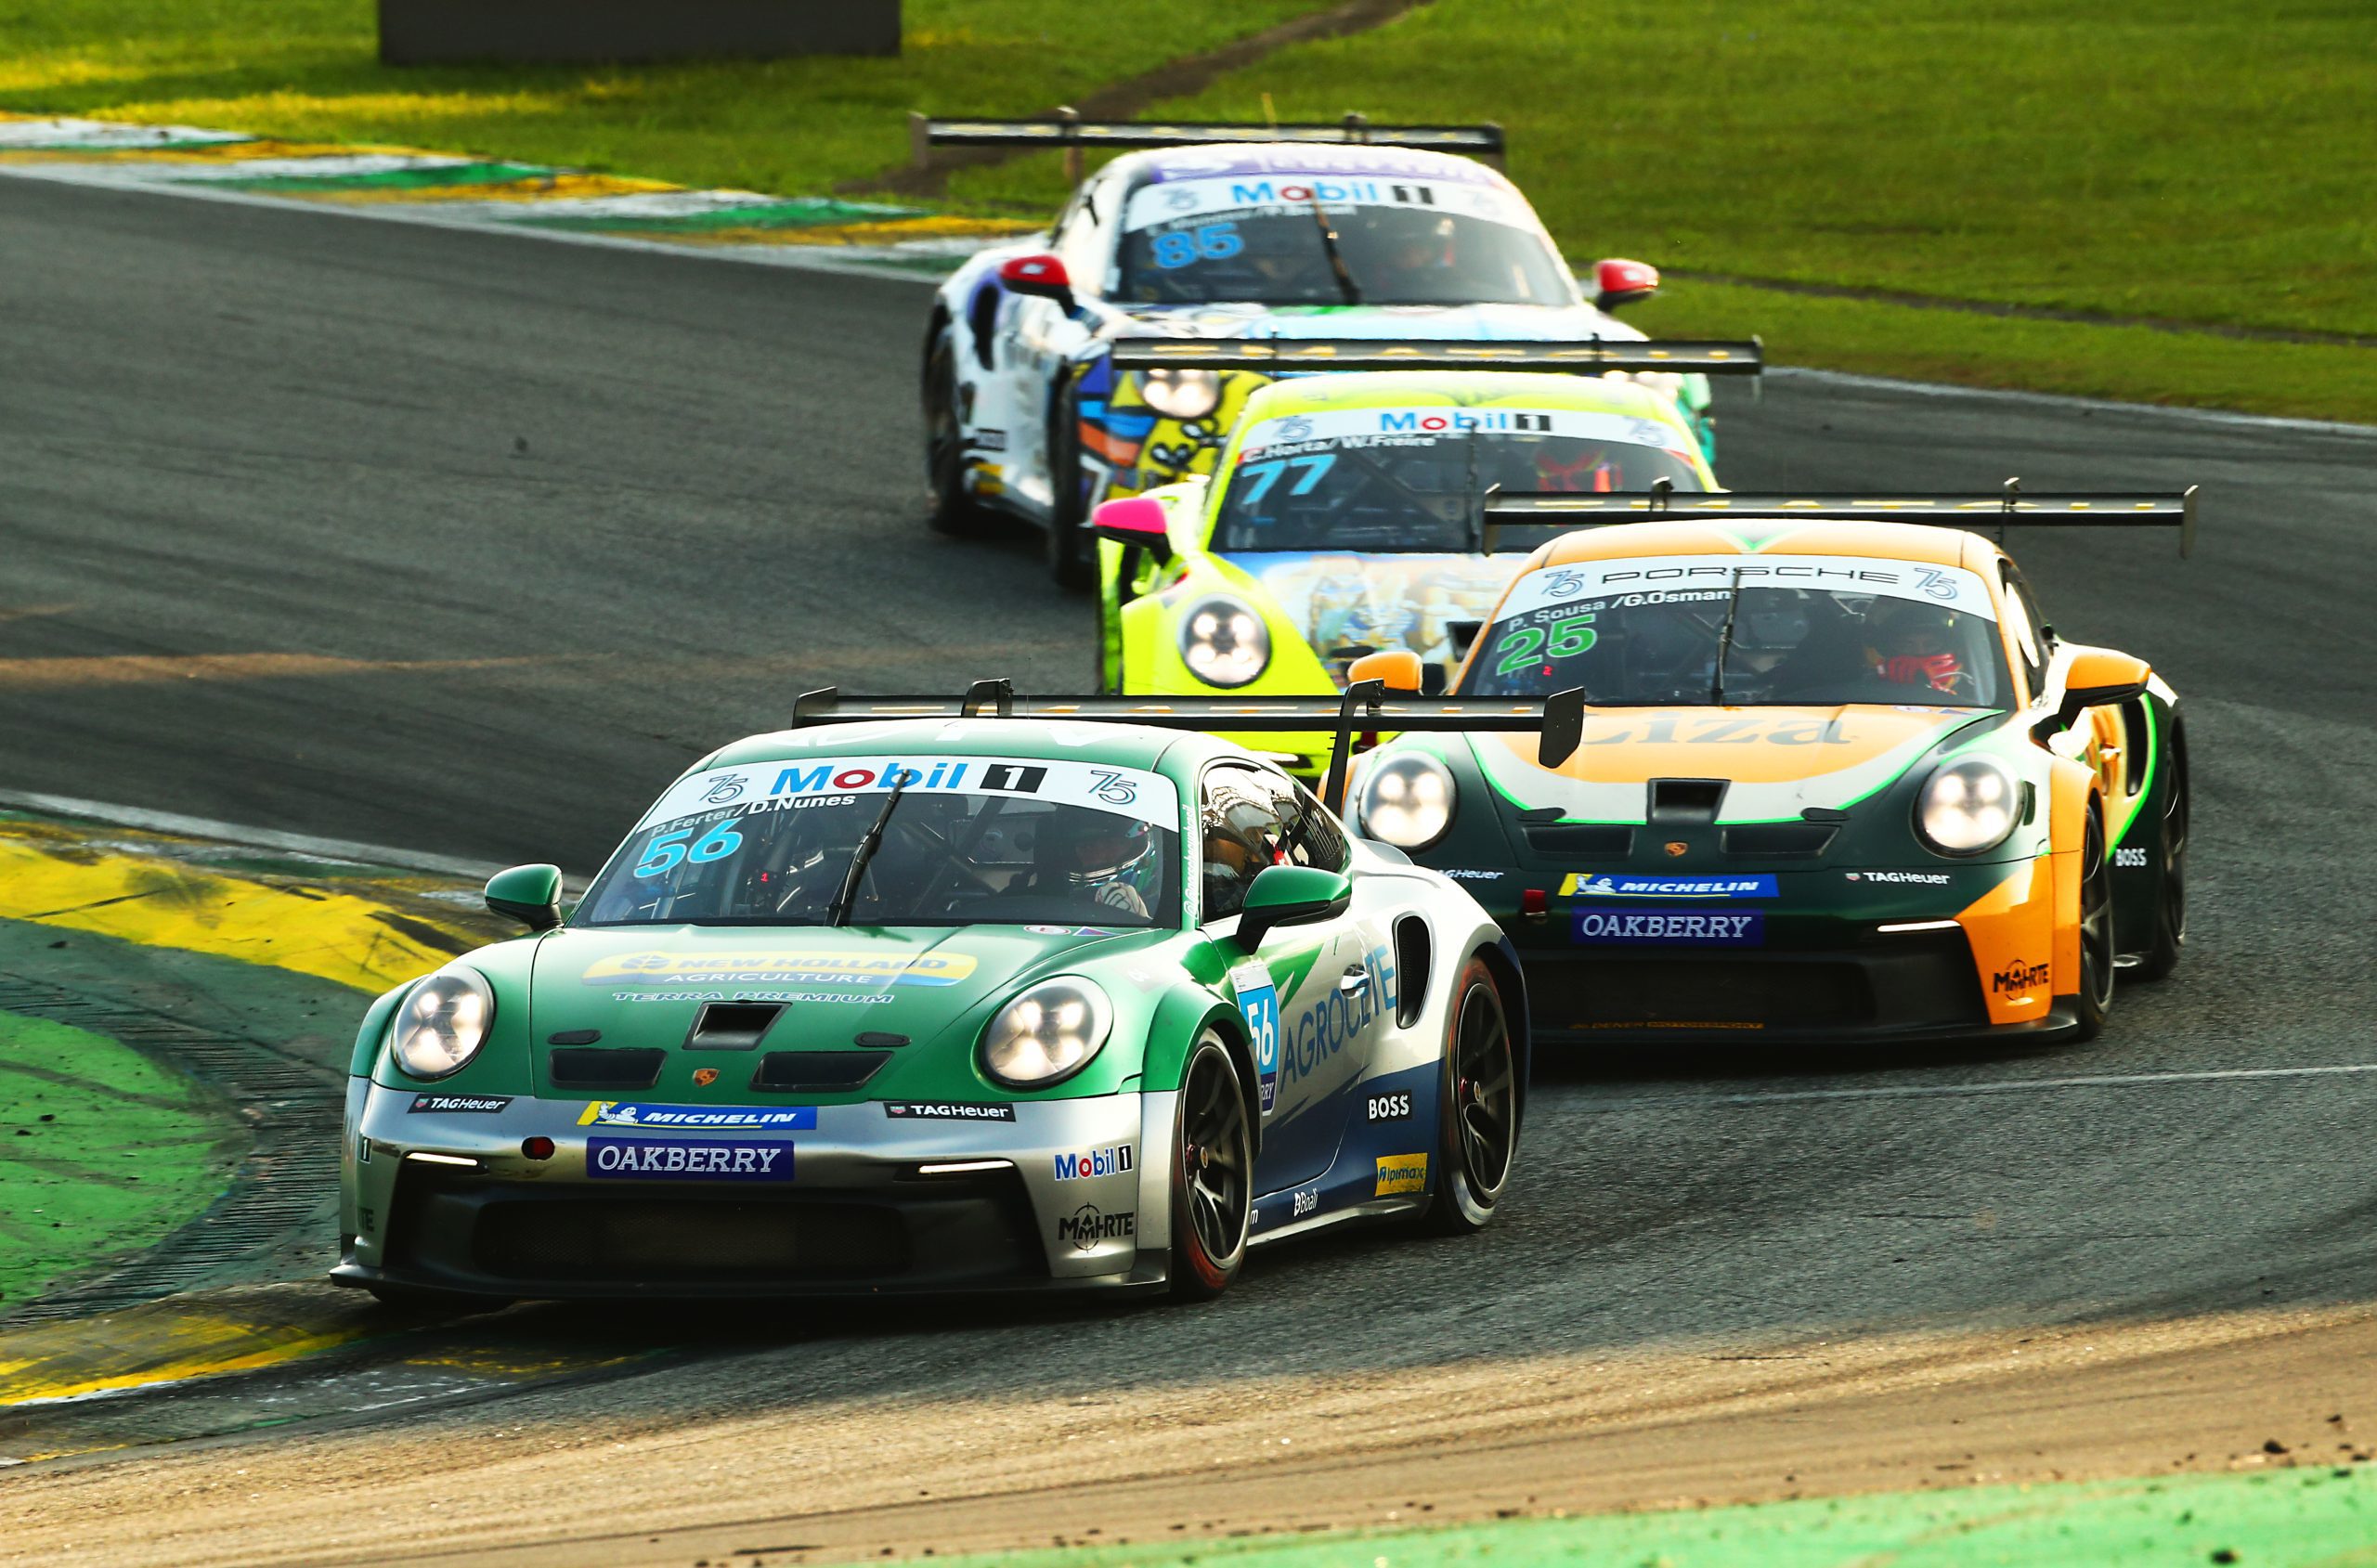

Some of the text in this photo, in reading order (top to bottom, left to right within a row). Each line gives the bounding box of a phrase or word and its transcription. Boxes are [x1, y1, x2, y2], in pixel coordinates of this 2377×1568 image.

[1231, 182, 1379, 203] Mobil
[1150, 222, 1245, 269] 85
[1380, 413, 1507, 431] Mobil
[1240, 454, 1337, 505] 77
[1544, 570, 1585, 598] 75
[1602, 566, 1900, 585] PORSCHE
[1914, 567, 1957, 600] 75
[1534, 599, 1607, 624] Sousa
[1496, 614, 1597, 677] 25
[699, 773, 749, 804] 75
[769, 761, 968, 796] Mobil
[1088, 769, 1137, 805] 75
[633, 816, 744, 879] 56
[2115, 849, 2148, 867] BOSS
[1437, 869, 1504, 880] GHeuer
[1619, 881, 1760, 893] MICHELIN
[1582, 914, 1752, 939] OAKBERRY
[676, 958, 948, 970] NEW HOLLAND
[664, 972, 873, 984] AGRICULTURE
[612, 991, 895, 1004] TERRA PREMIUM
[1247, 998, 1274, 1066] 56
[643, 1112, 797, 1123] MICHELIN
[1369, 1095, 1409, 1120] BOSS
[597, 1146, 781, 1173] OAKBERRY
[1054, 1147, 1116, 1181] Mobil
